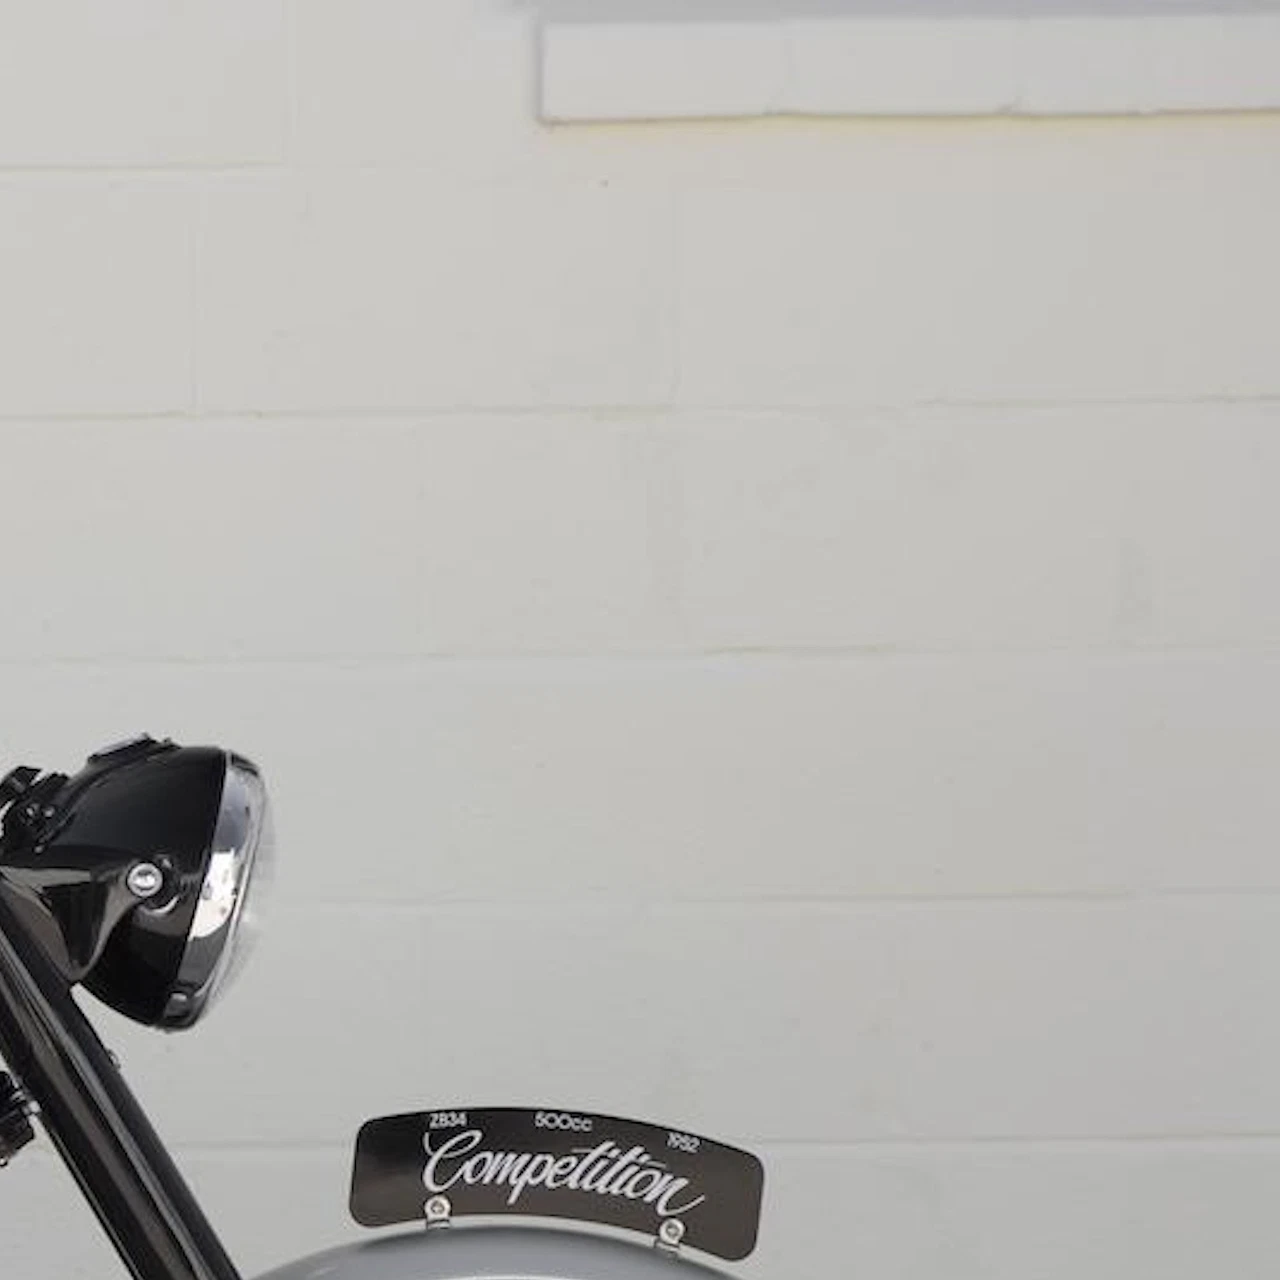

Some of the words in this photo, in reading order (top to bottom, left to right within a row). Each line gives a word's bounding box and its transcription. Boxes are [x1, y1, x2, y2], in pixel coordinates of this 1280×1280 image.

[429, 1111, 467, 1129] ZB34
[534, 1111, 593, 1132] 500cc
[667, 1132, 700, 1153] 1952
[422, 1129, 705, 1216] Competition
